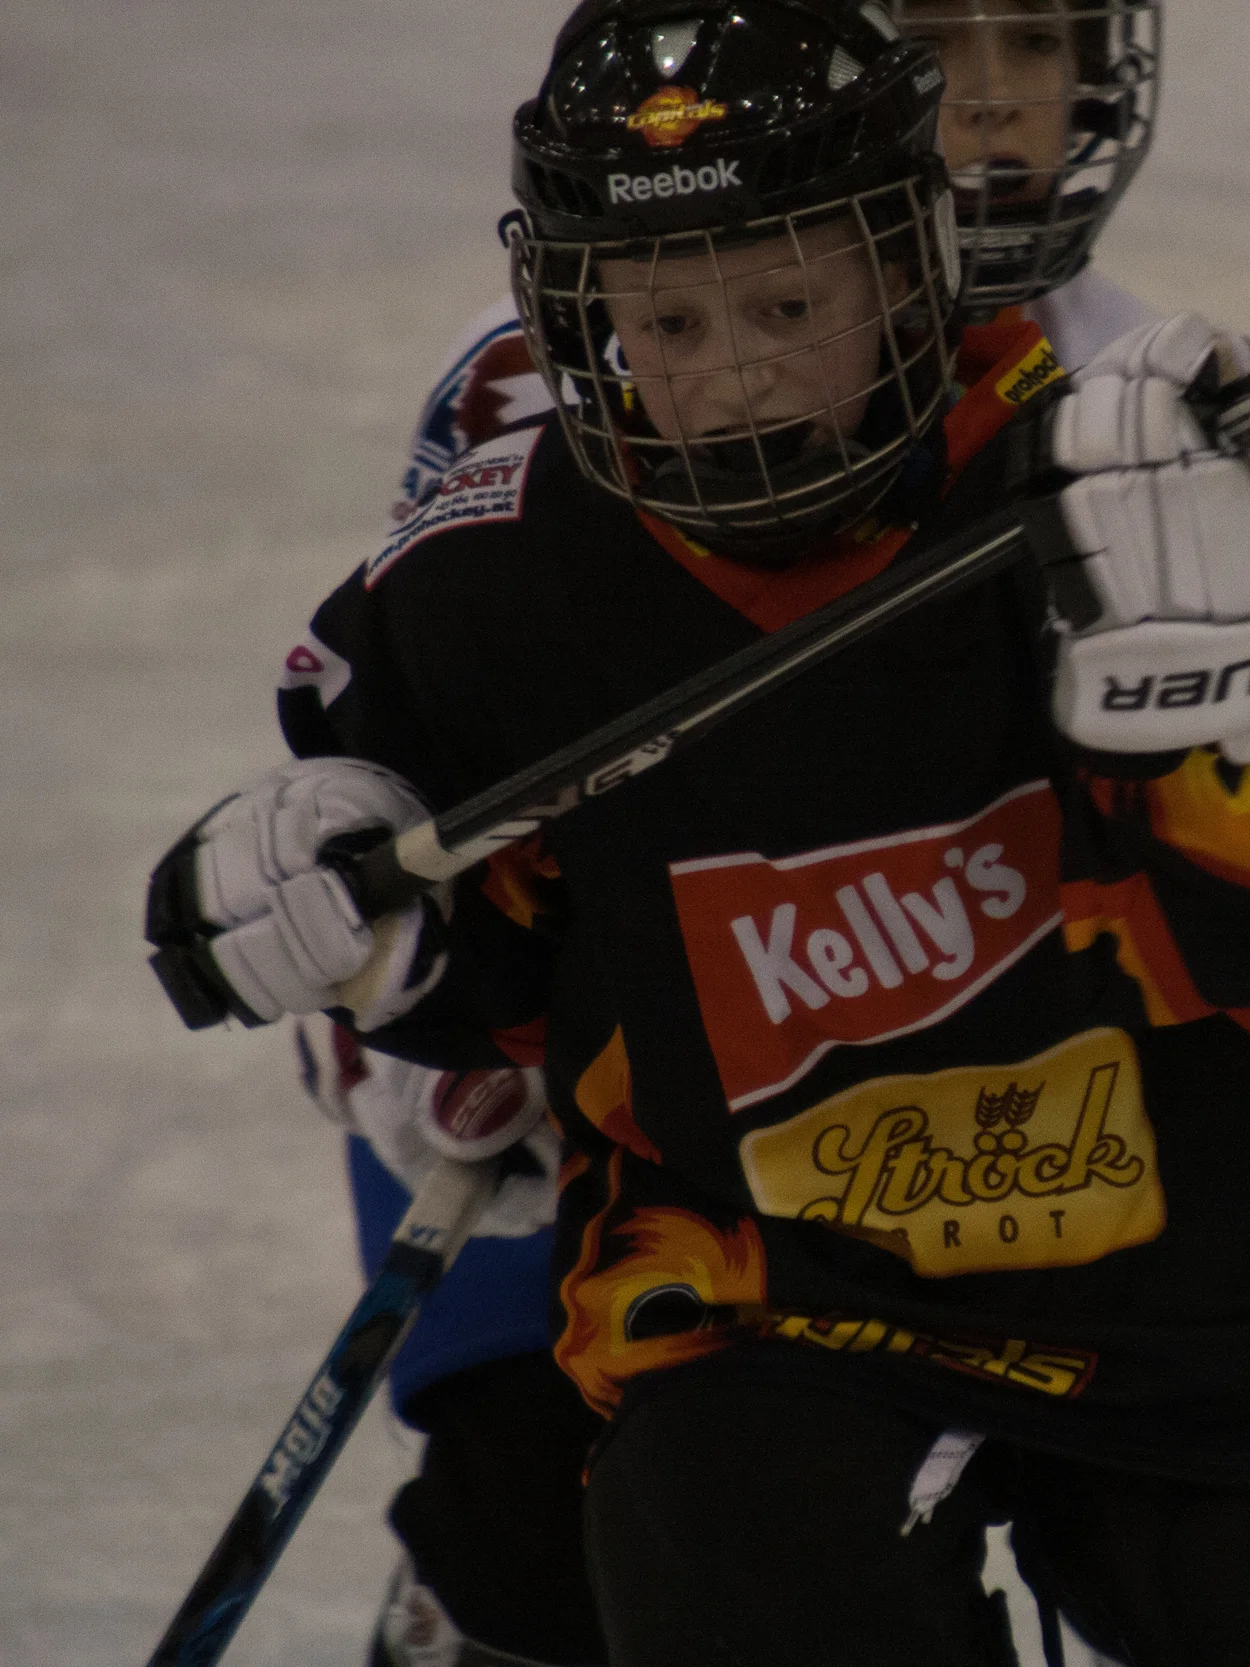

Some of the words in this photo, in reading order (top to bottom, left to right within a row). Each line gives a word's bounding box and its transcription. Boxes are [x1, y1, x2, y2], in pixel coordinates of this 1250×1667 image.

[608, 158, 743, 205] Reebok
[730, 843, 1028, 1026] Kelly's
[798, 1061, 1145, 1227] Ströck
